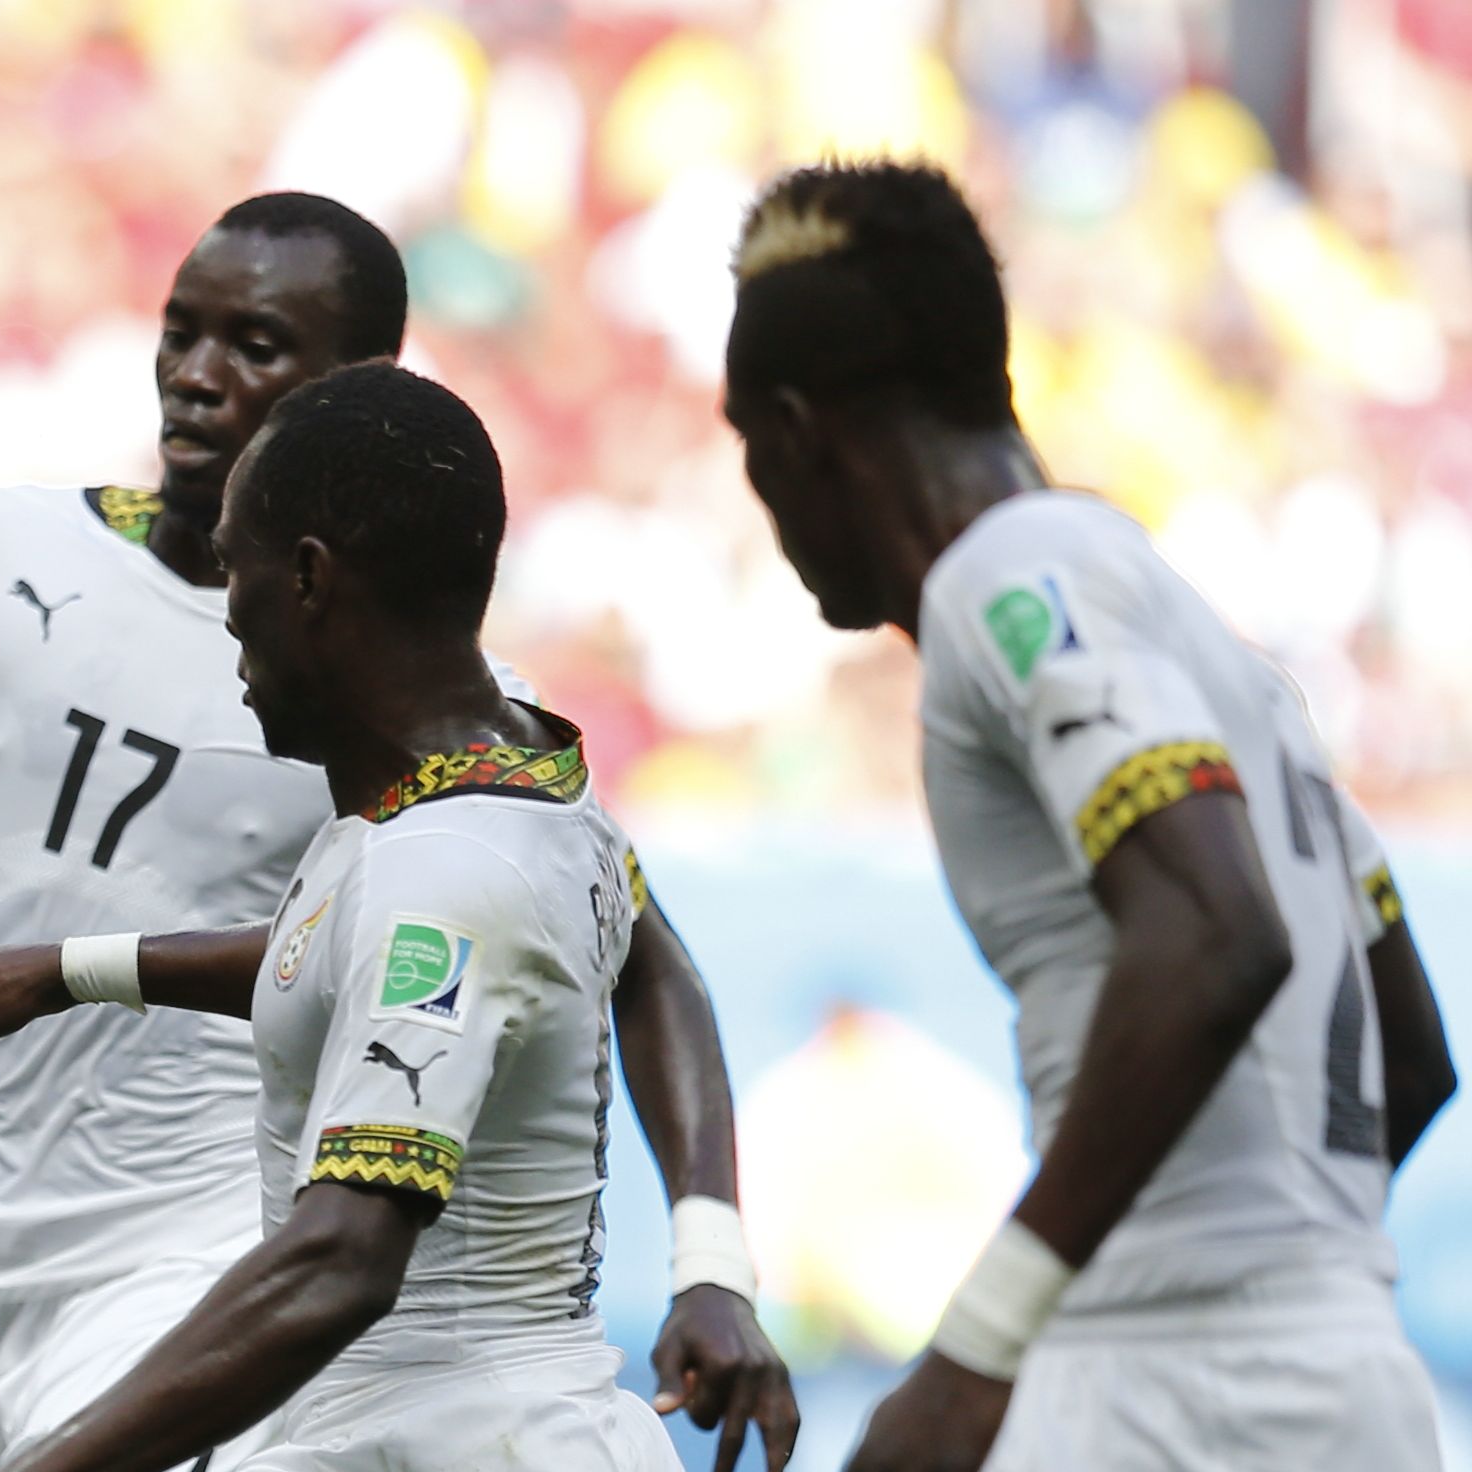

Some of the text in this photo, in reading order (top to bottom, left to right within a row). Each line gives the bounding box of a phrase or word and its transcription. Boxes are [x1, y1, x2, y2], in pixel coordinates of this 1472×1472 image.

[45, 708, 180, 870] 17
[392, 949, 444, 966] FOR HOPE
[396, 941, 447, 959] FOOTBALL
